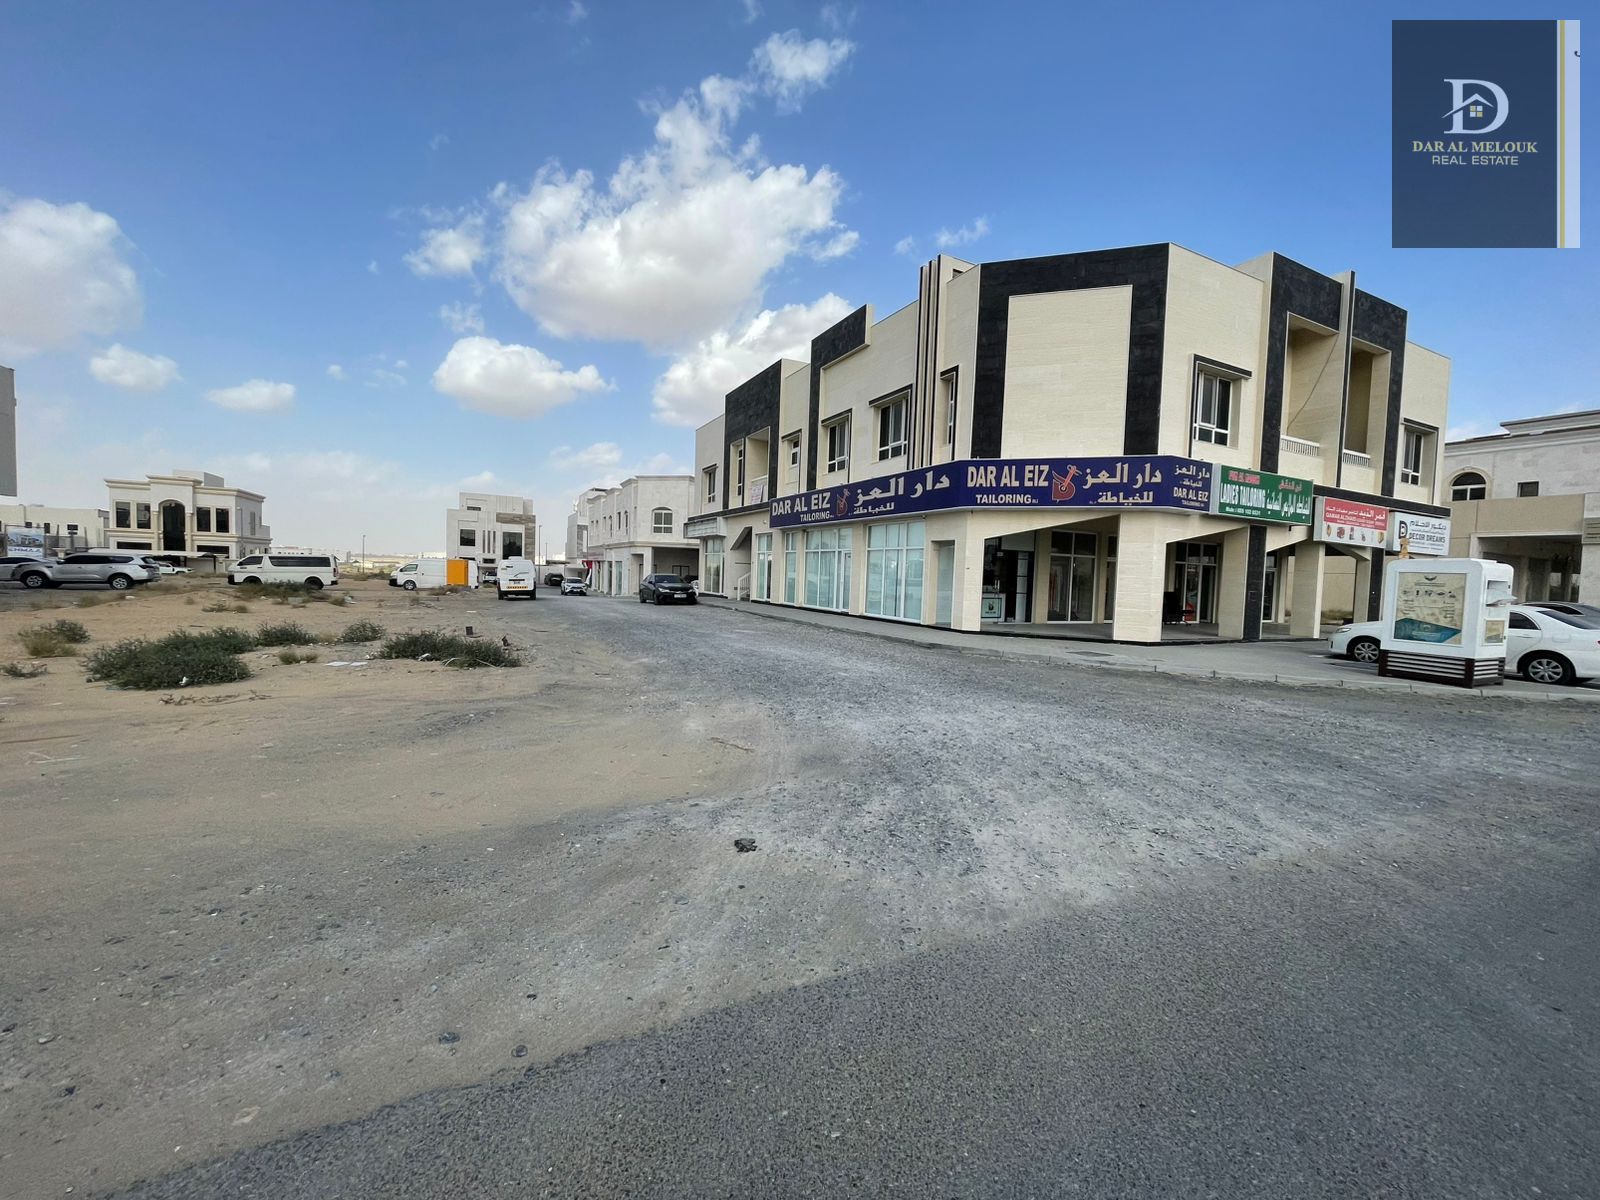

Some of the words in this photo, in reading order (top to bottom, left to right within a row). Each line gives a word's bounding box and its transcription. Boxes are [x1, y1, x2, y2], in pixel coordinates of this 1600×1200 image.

[967, 465, 996, 488] DAR
[1000, 465, 1020, 487] AL
[1024, 464, 1050, 487] EIZ
[1082, 461, 1128, 489] العز
[1133, 462, 1162, 489] دار
[1174, 464, 1196, 475] العز
[1197, 467, 1210, 479] دار
[853, 476, 904, 507] العز
[910, 470, 950, 498] دار
[1220, 482, 1240, 505] LADIES
[976, 494, 1031, 504] TAILORING
[1097, 491, 1153, 506] للخياطة
[1173, 486, 1188, 499] DAR
[1188, 489, 1197, 500] AL
[1198, 490, 1209, 502] EIZ
[772, 500, 792, 516] DAR
[793, 497, 807, 513] AL
[811, 492, 831, 510] EIZ
[853, 502, 894, 515] للخياطة
[800, 511, 830, 522] TAILORING
